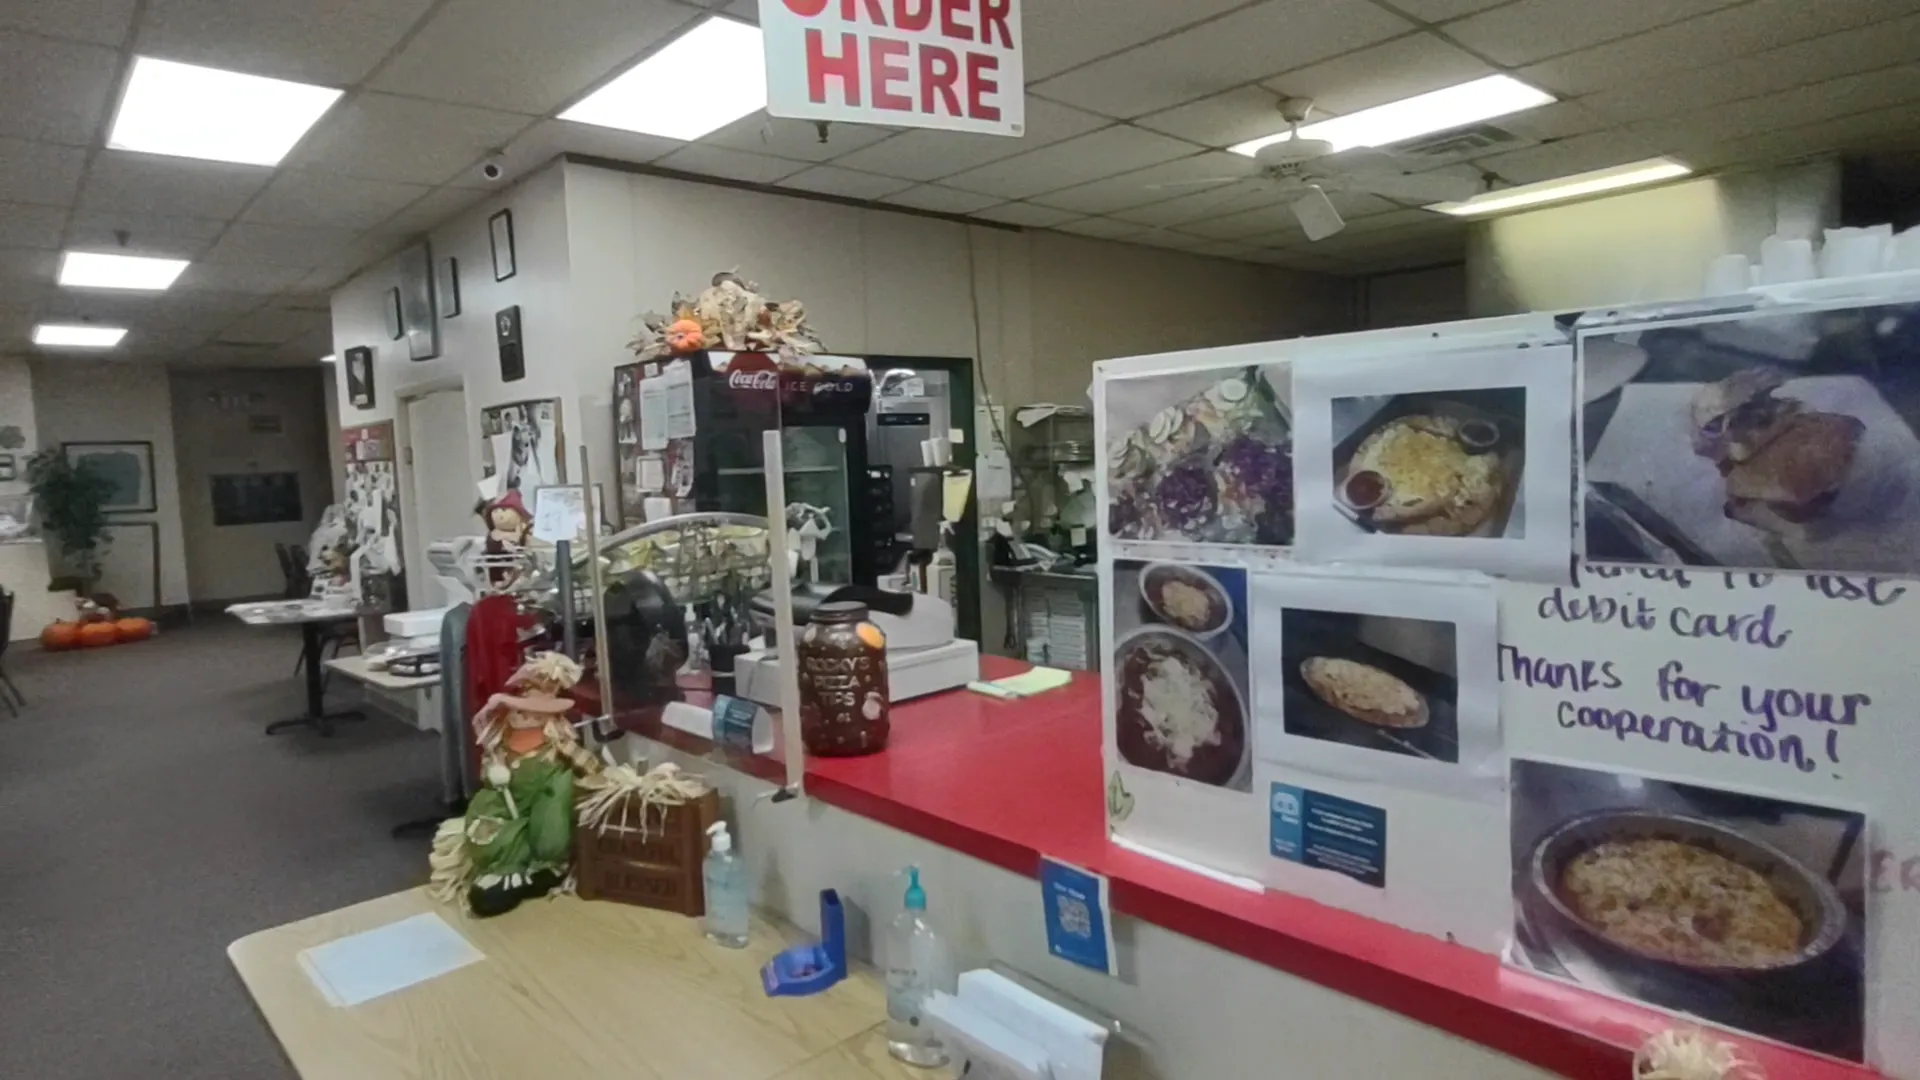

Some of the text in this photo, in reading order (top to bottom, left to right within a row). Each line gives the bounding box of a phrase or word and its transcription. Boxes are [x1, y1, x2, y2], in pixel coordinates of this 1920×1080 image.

[782, 0, 1015, 49] DER
[805, 28, 1001, 122] HERE
[1538, 586, 1793, 648] debit card
[818, 691, 856, 708] TIPS
[1497, 643, 1872, 733] Thanks for your
